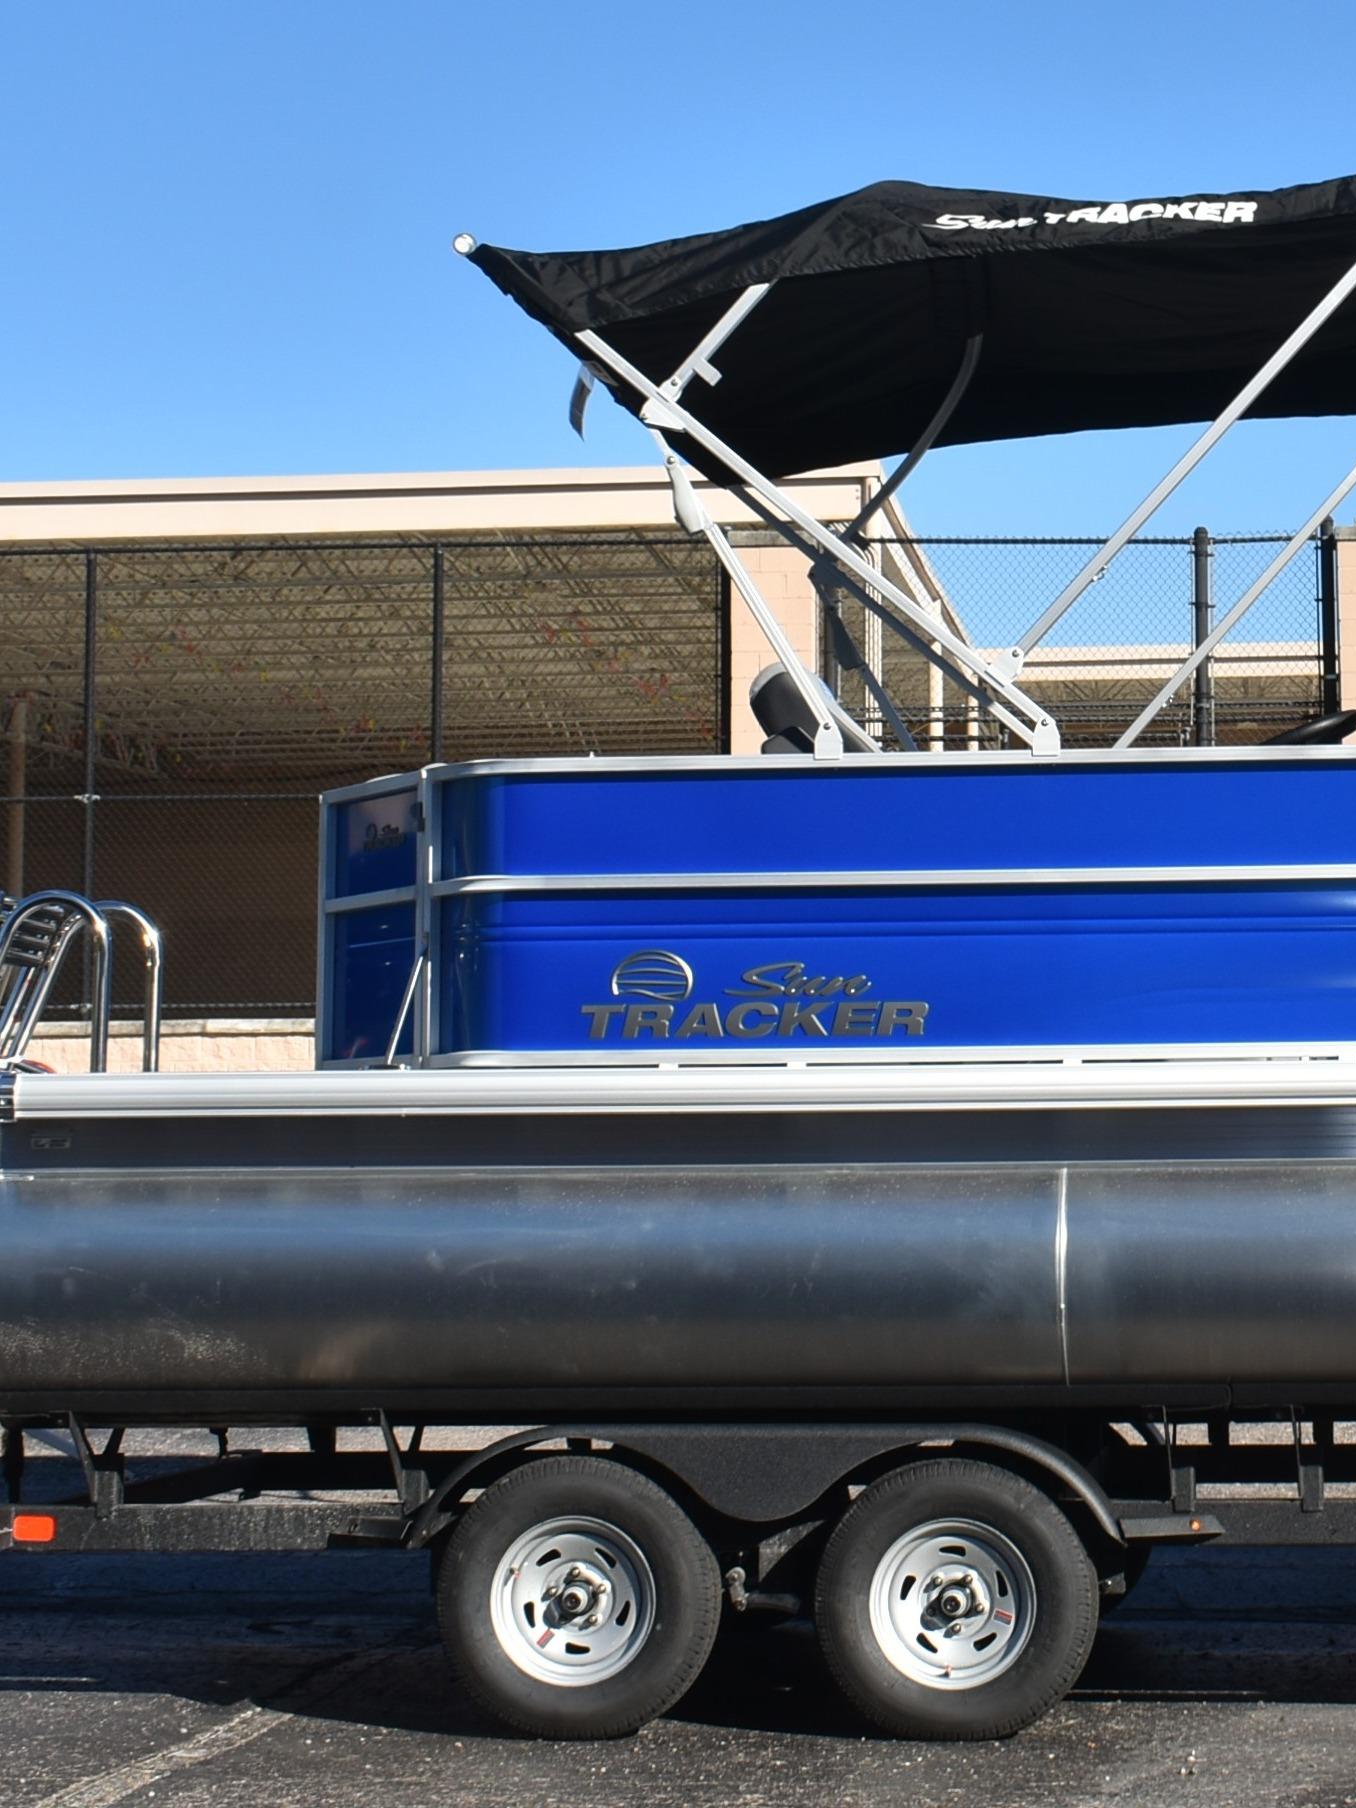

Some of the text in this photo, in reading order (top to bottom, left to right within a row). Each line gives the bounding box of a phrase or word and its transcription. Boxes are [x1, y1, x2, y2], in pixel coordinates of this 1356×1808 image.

[922, 201, 1258, 230] Sun TRACKER
[723, 961, 873, 998] Sun
[580, 1001, 930, 1040] TRACKER
